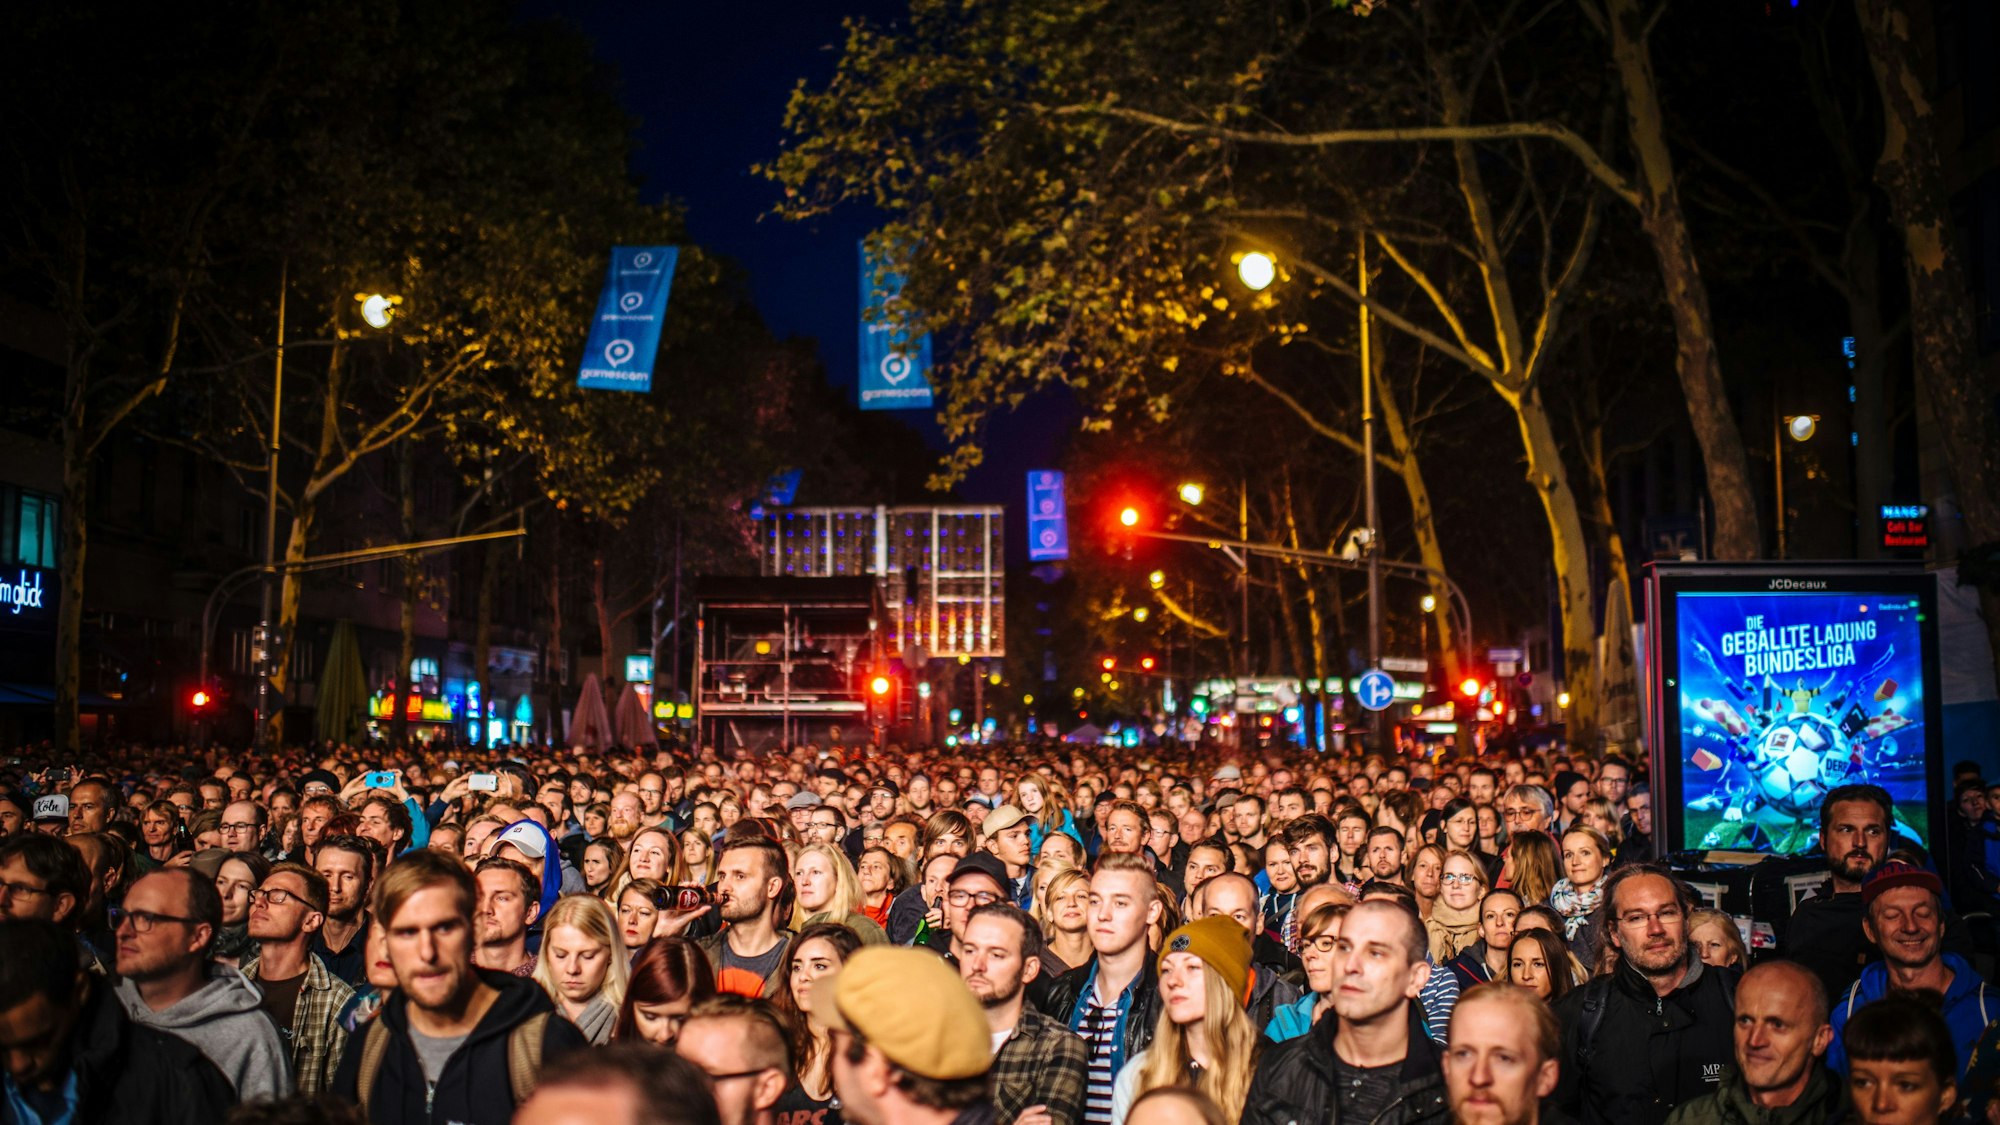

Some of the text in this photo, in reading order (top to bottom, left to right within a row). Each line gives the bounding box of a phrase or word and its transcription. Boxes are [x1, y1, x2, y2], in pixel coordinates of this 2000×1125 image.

[580, 368, 649, 381] gamescom
[862, 388, 931, 402] gamescom
[12, 569, 42, 614] glück
[1768, 579, 1828, 590] JCDecaux
[1746, 615, 1764, 631] DIE
[1721, 620, 1877, 656] GEBALLTE LADUNG
[1745, 644, 1856, 677] BUNDESLIGA
[36, 799, 60, 813] Köln
